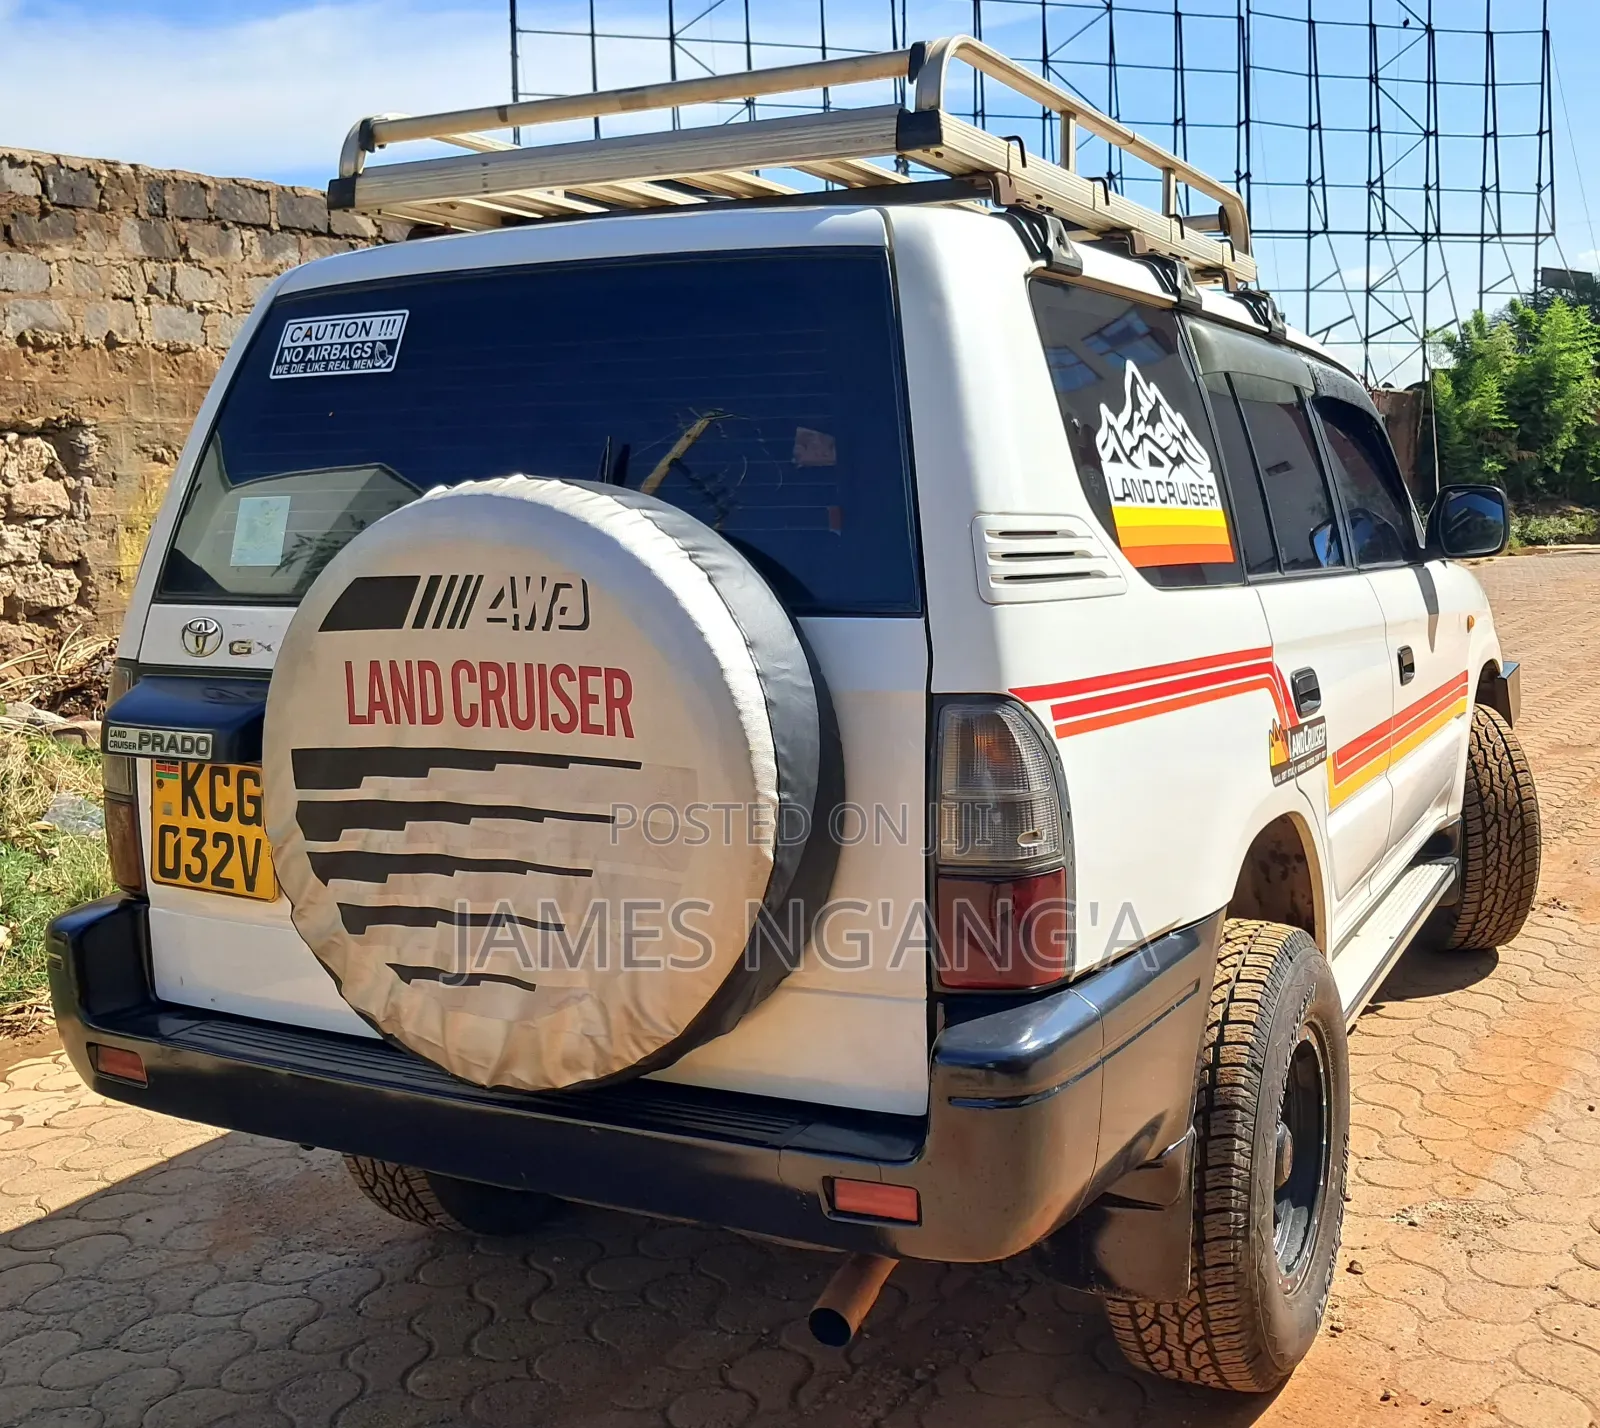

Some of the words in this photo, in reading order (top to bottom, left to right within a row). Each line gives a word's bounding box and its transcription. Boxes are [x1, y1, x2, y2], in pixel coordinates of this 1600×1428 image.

[290, 320, 373, 343] CAUTION
[378, 318, 397, 337] !!!
[282, 347, 304, 363] NO
[305, 342, 373, 361] AIRBAGS
[275, 364, 289, 374] WE
[290, 363, 306, 373] DIE
[306, 361, 326, 372] LIKE
[327, 360, 350, 371] REAL
[352, 359, 374, 369] MEN
[1108, 476, 1155, 503] LAND
[1156, 480, 1218, 507] CRUISER
[345, 660, 444, 725] LAND
[451, 659, 634, 739] CRUISER
[109, 729, 127, 738] LAND
[109, 740, 137, 750] CRUISER
[138, 731, 210, 756] PRADO
[181, 761, 262, 827] KCG
[158, 824, 262, 892] 032V
